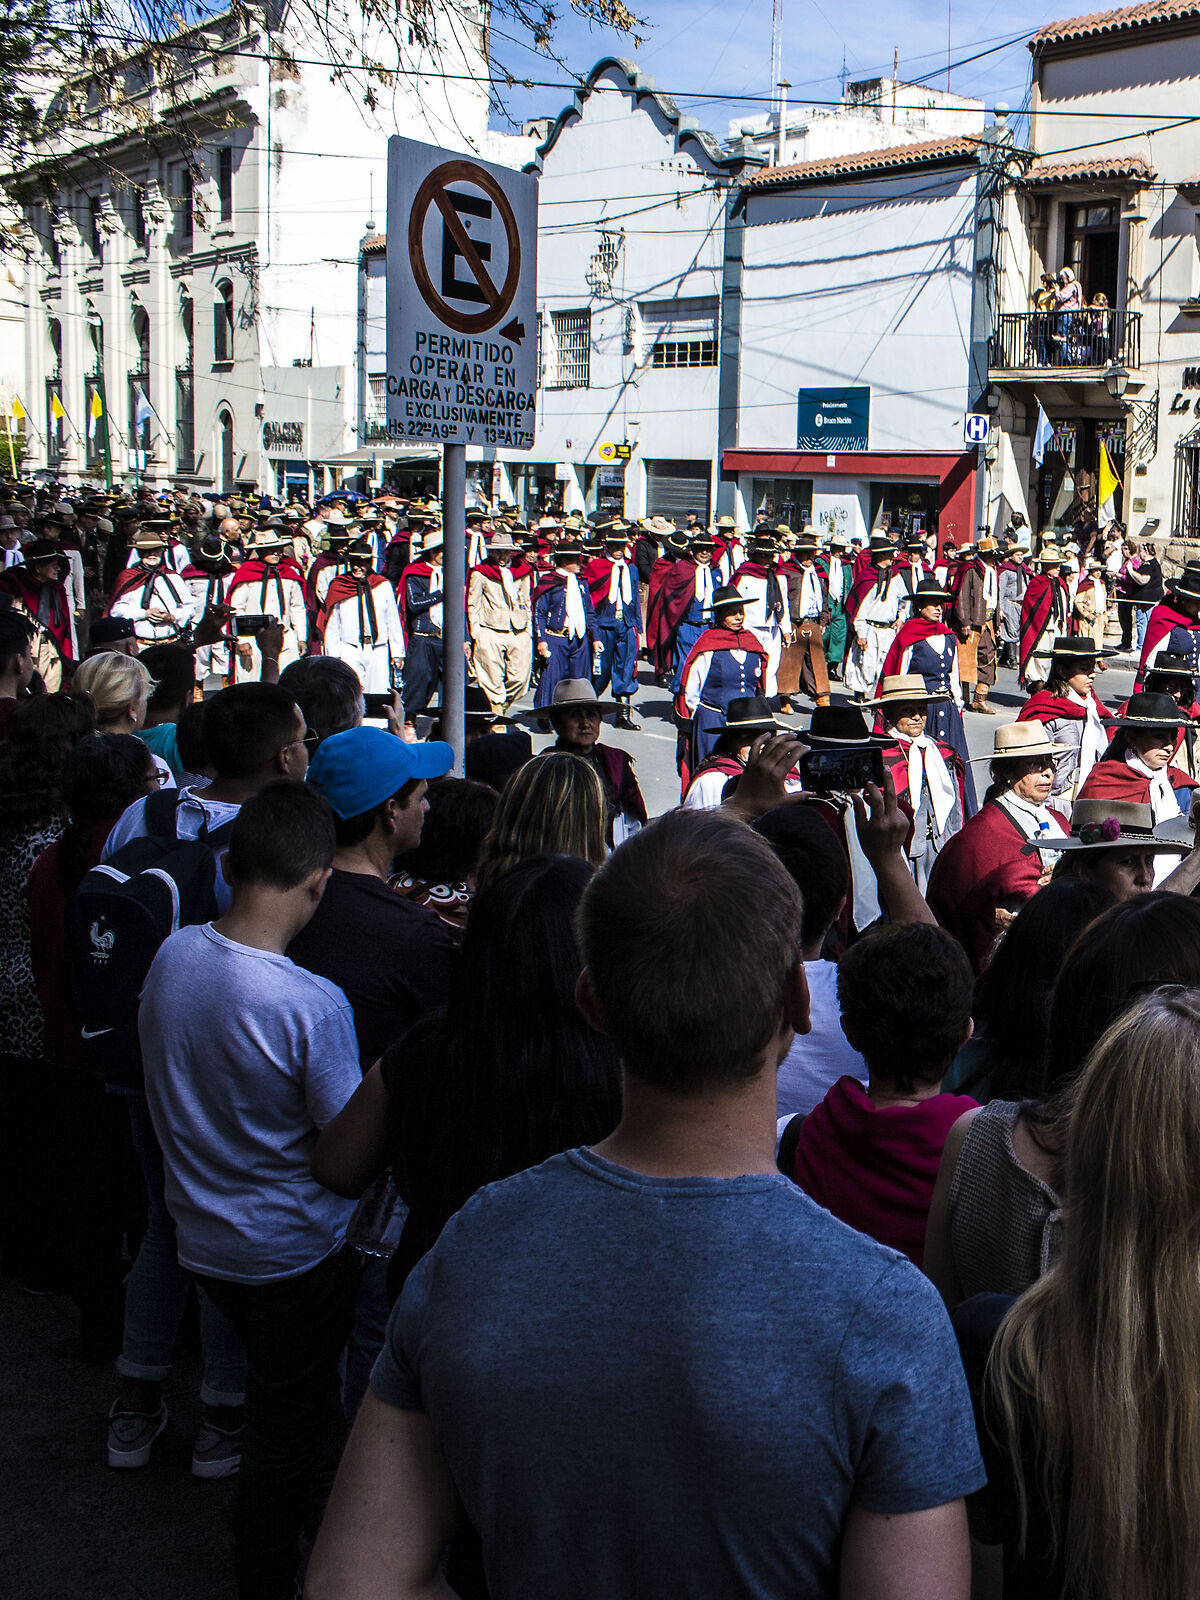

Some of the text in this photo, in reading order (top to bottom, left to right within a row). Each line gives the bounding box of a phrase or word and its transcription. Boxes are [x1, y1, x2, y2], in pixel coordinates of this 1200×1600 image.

[441, 188, 493, 305] E
[416, 331, 513, 364] PERMITIDO
[410, 355, 516, 387] OPERAR EN
[386, 376, 441, 401] CARGA
[456, 384, 536, 412] DESCARGA
[1168, 392, 1191, 415] La
[405, 401, 522, 428] EXCLUSIVAMENTE
[970, 416, 985, 439] H
[466, 425, 474, 441] Y
